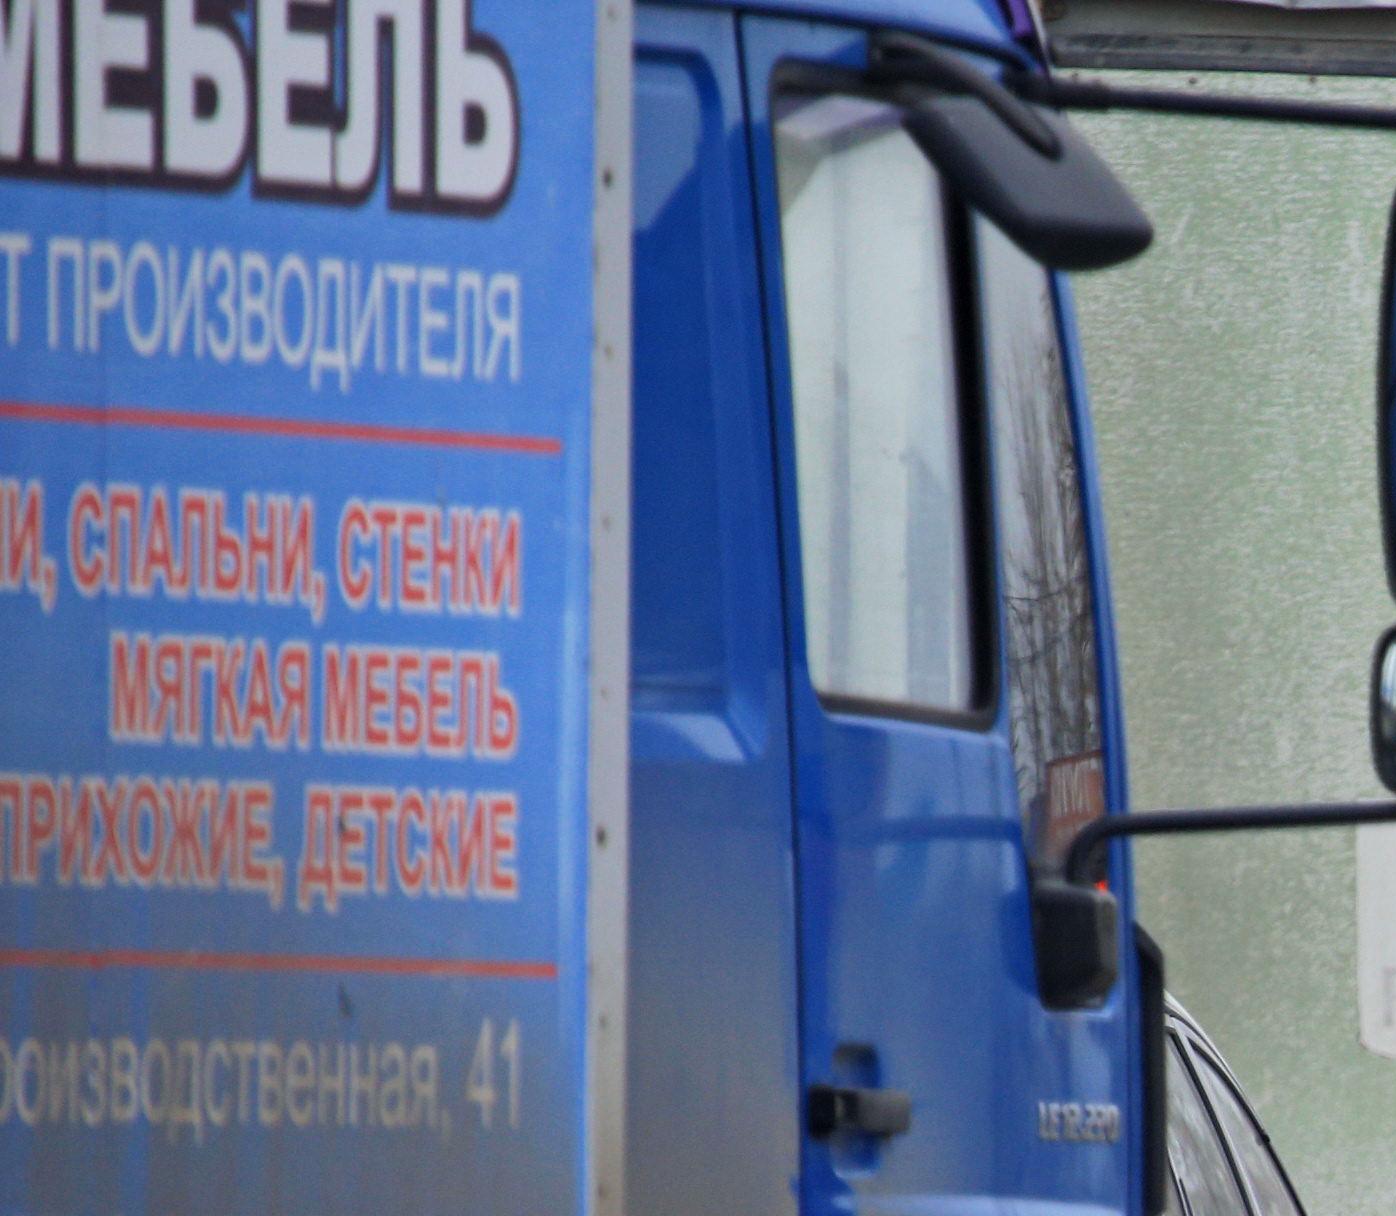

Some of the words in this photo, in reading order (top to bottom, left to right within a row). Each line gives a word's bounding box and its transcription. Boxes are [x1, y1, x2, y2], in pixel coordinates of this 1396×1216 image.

[0, 0, 520, 213] МЕБЕЛЬ
[46, 238, 522, 393] ПРОИЗВОДИТЕЛЯ
[0, 476, 56, 611] И,
[70, 482, 327, 622] СПАЛЬНИ,
[338, 498, 522, 617] СТЕНКИ
[109, 630, 310, 748] МЯГКАЯ
[322, 640, 519, 760] МЕБЕЛЬ
[0, 772, 284, 910] ПРИХОЖИЕ,
[297, 782, 519, 913] ДЕТСКИЕ
[465, 1016, 521, 1131] 41
